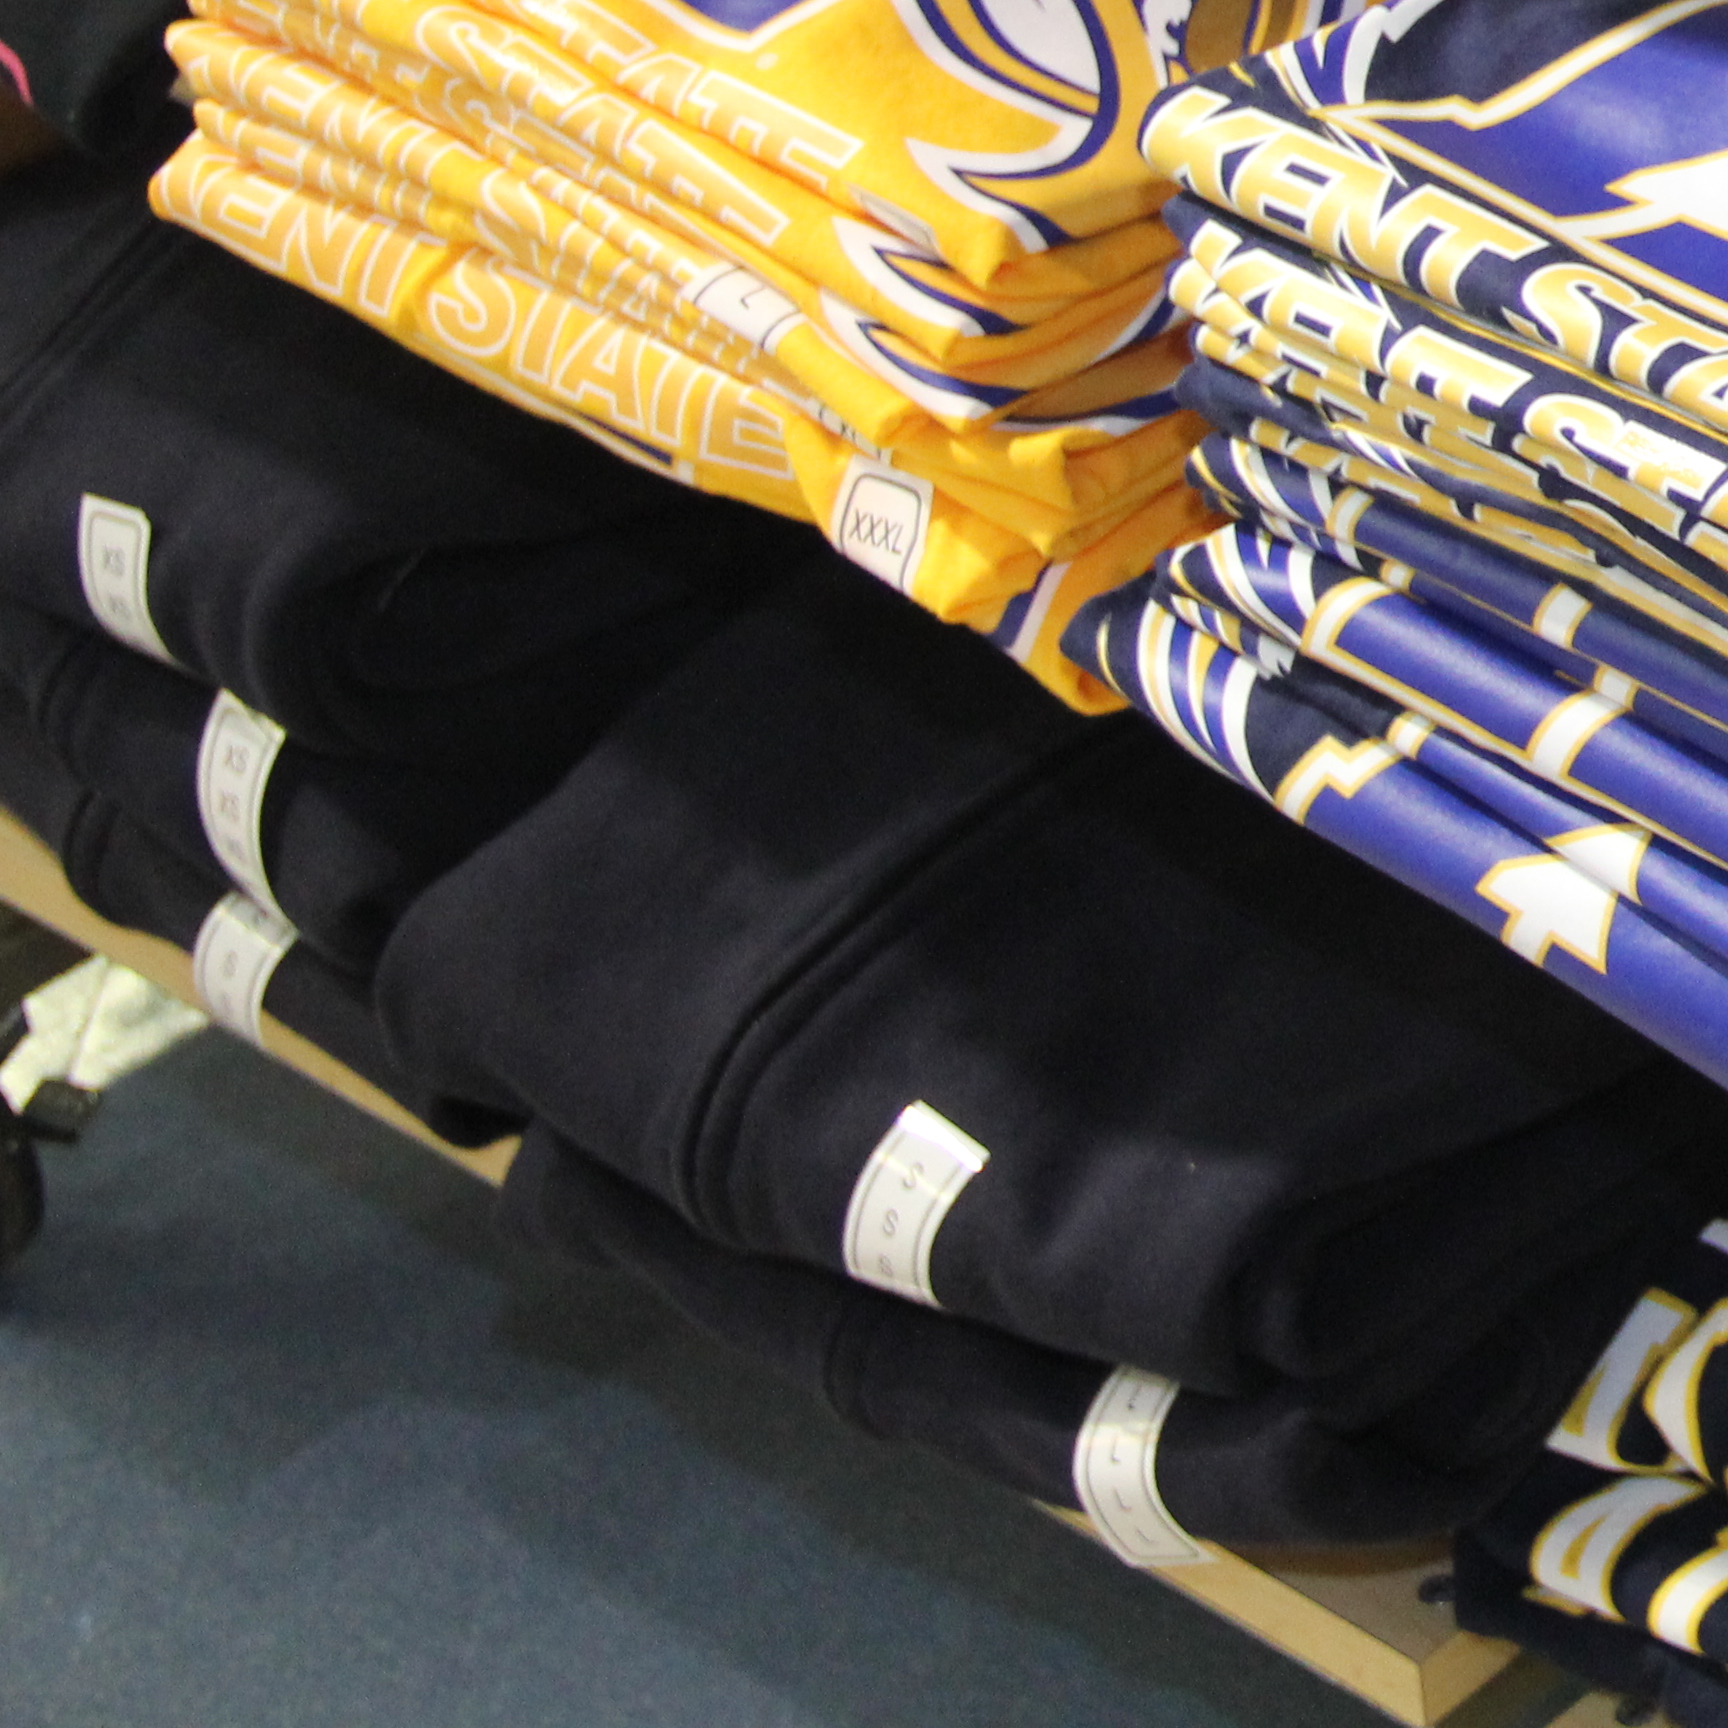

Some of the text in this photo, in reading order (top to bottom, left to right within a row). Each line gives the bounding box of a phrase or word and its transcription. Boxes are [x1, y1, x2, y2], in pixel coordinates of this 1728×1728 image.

[1137, 85, 1549, 309] KENT
[848, 509, 904, 556] XXXL
[882, 1208, 900, 1238] S
